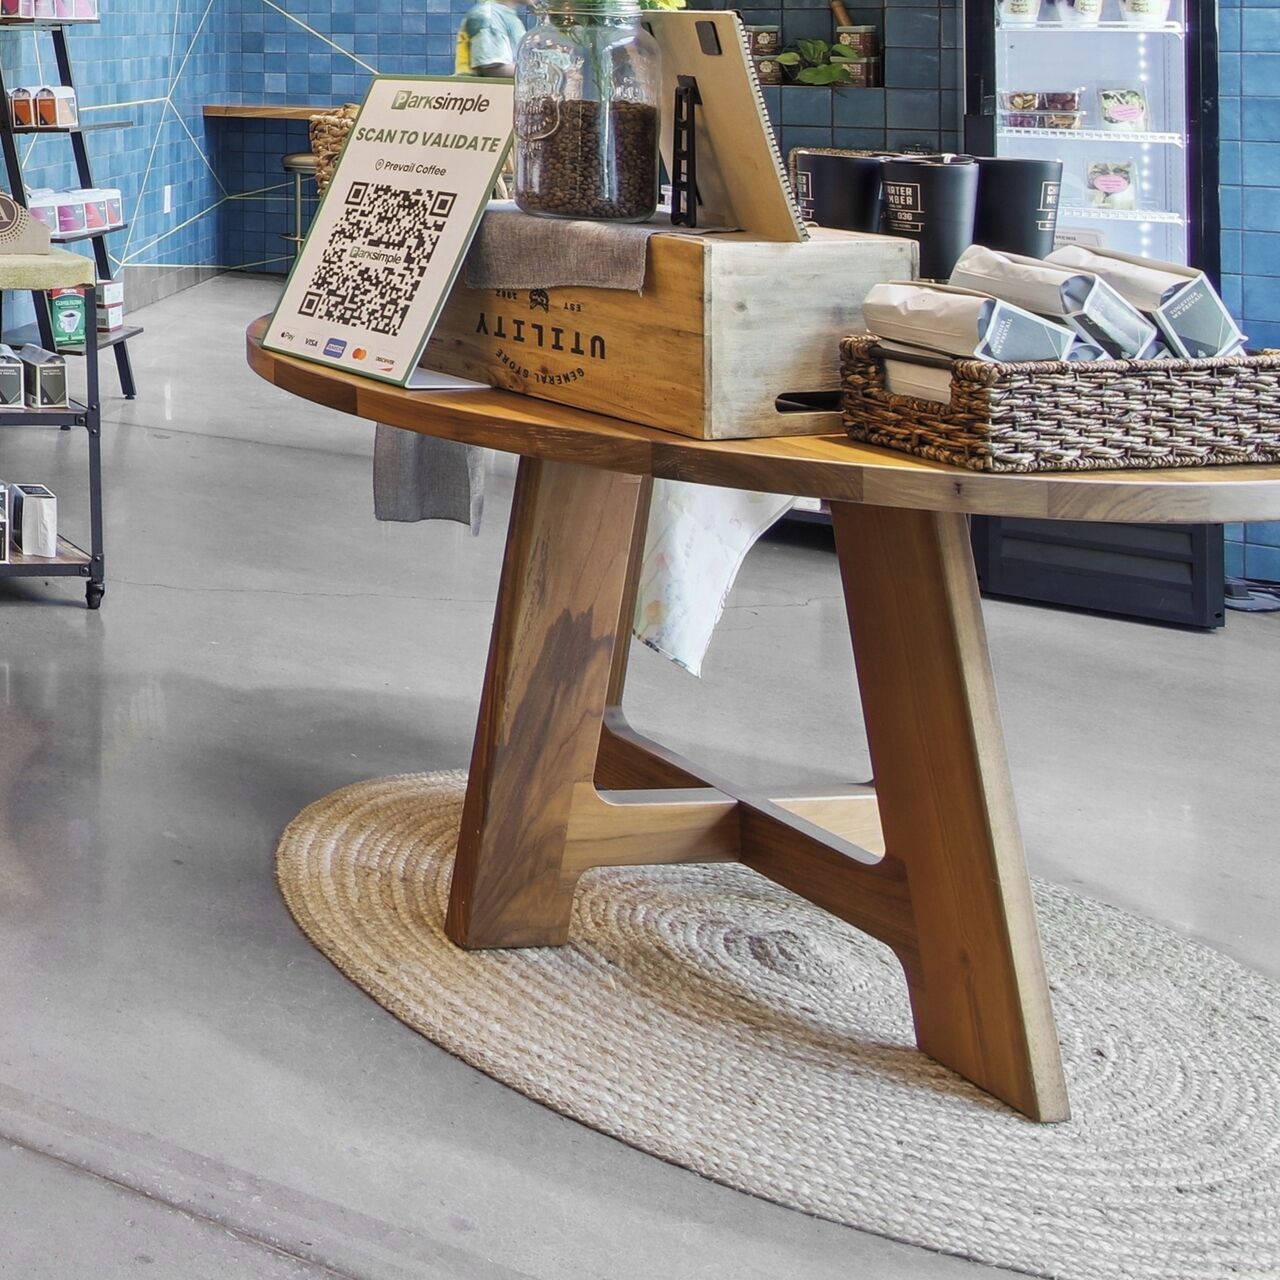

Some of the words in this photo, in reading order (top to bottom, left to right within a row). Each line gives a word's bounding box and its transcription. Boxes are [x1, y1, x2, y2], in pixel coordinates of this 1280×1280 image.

[391, 90, 490, 115] Parksimple
[356, 127, 398, 144] SCAN
[398, 130, 419, 145] TO
[421, 132, 502, 153] VALIDATE
[384, 160, 415, 173] Prevail
[416, 164, 447, 176] Coffee
[350, 246, 402, 265] Parksimple
[564, 302, 582, 312] EST
[305, 338, 319, 347] VISA
[476, 312, 606, 360] UTILITY
[496, 348, 530, 379] STORE
[536, 368, 585, 385] GENERAL
